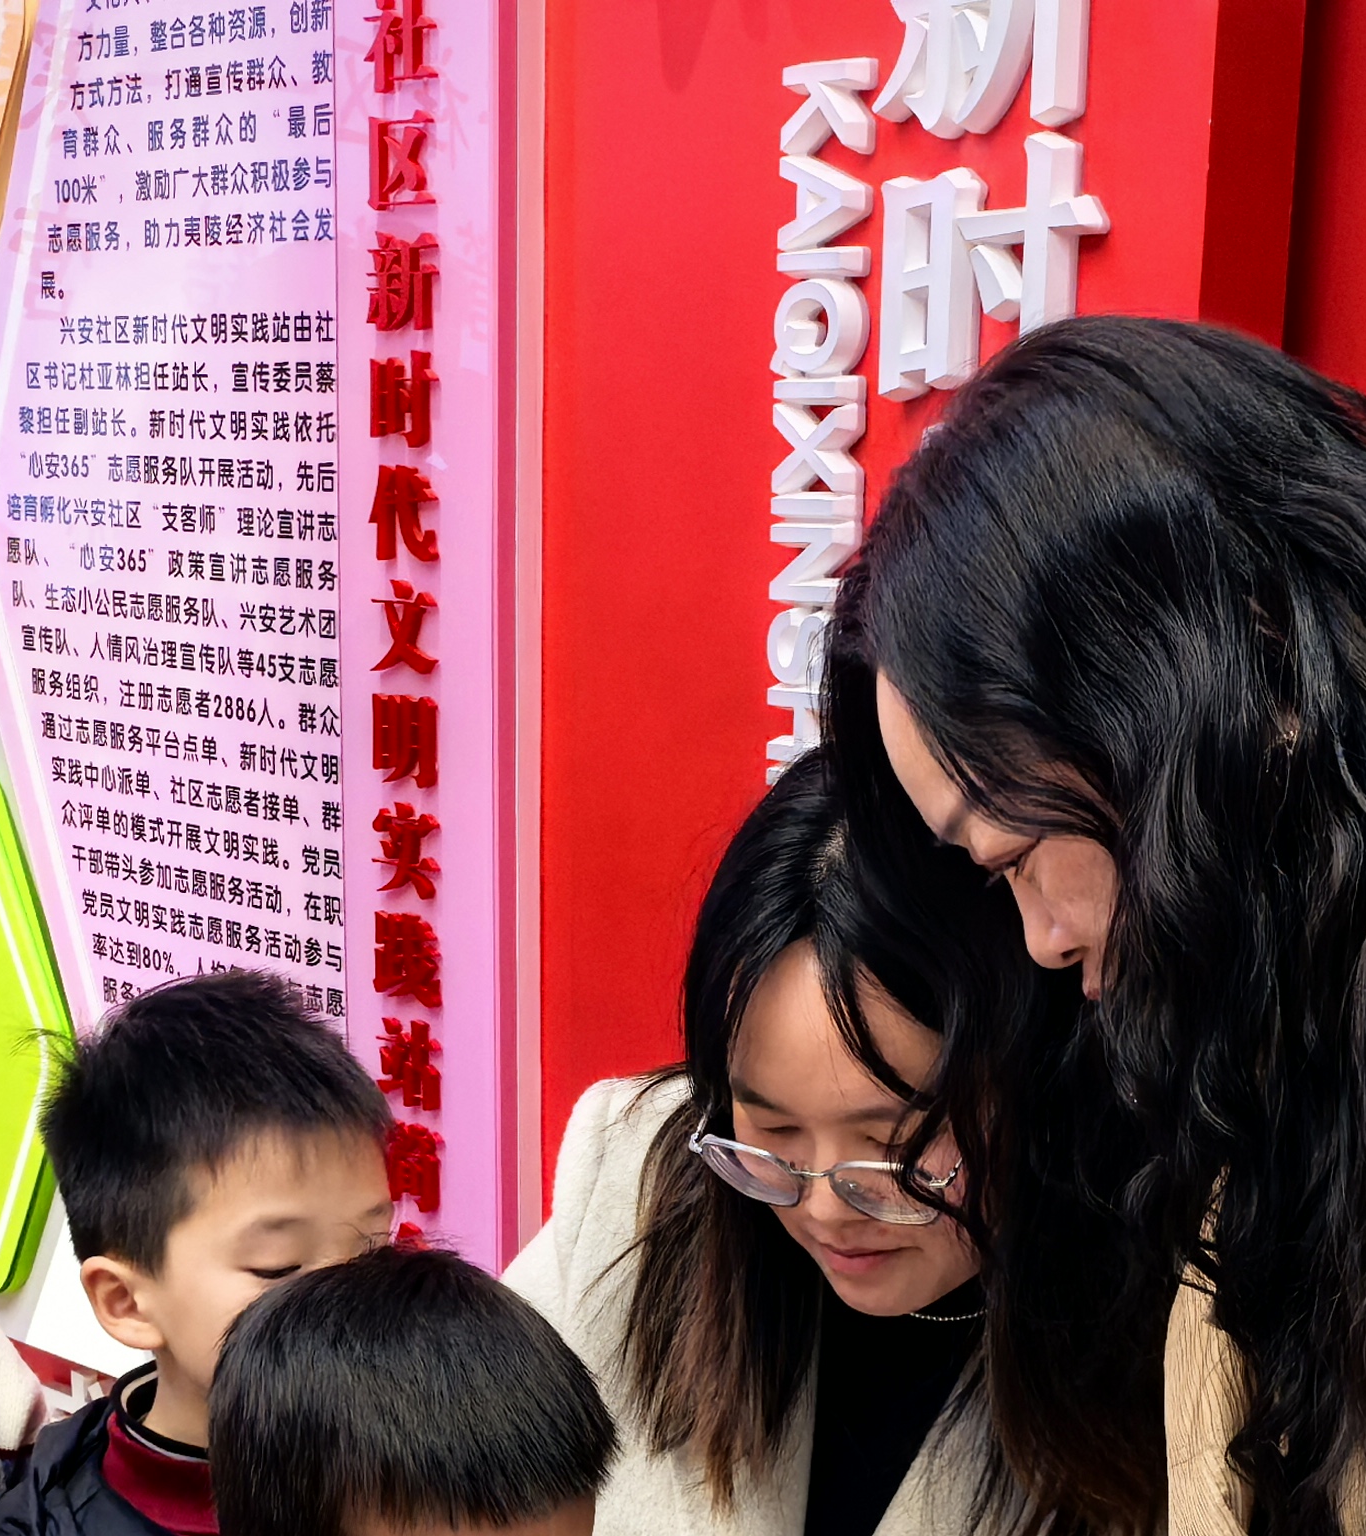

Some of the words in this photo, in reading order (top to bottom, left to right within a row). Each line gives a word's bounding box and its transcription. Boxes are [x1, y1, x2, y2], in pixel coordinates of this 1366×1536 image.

[70, 50, 333, 111] 方式方法，打通宣传群众、教
[47, 208, 335, 254] 志愿服务，助力夷陵经济社会发
[40, 271, 65, 301] 展。
[59, 310, 335, 346] 兴安社区新时代文明实践站由社
[26, 361, 336, 394] 区书记杜亚林担任站长，宣传委员蔡
[19, 406, 336, 445] 黎担任副站长。新时代文明实践依托
[12, 580, 337, 641] 队、生态小公民志愿服务队、兴安艺术团
[363, 0, 444, 1252] 社区新时代文明实践站简
[41, 711, 340, 786] 通过志愿服务平台点单、新时代文明
[51, 756, 342, 832] 实践中心派单、社区志愿者接单、群
[61, 800, 343, 880] 众评单的模式开展文明实践。党员
[72, 844, 344, 928] 干部带头参加志愿服务活动，在职
[82, 888, 343, 973] 党员文明实践志愿服务活动参与
